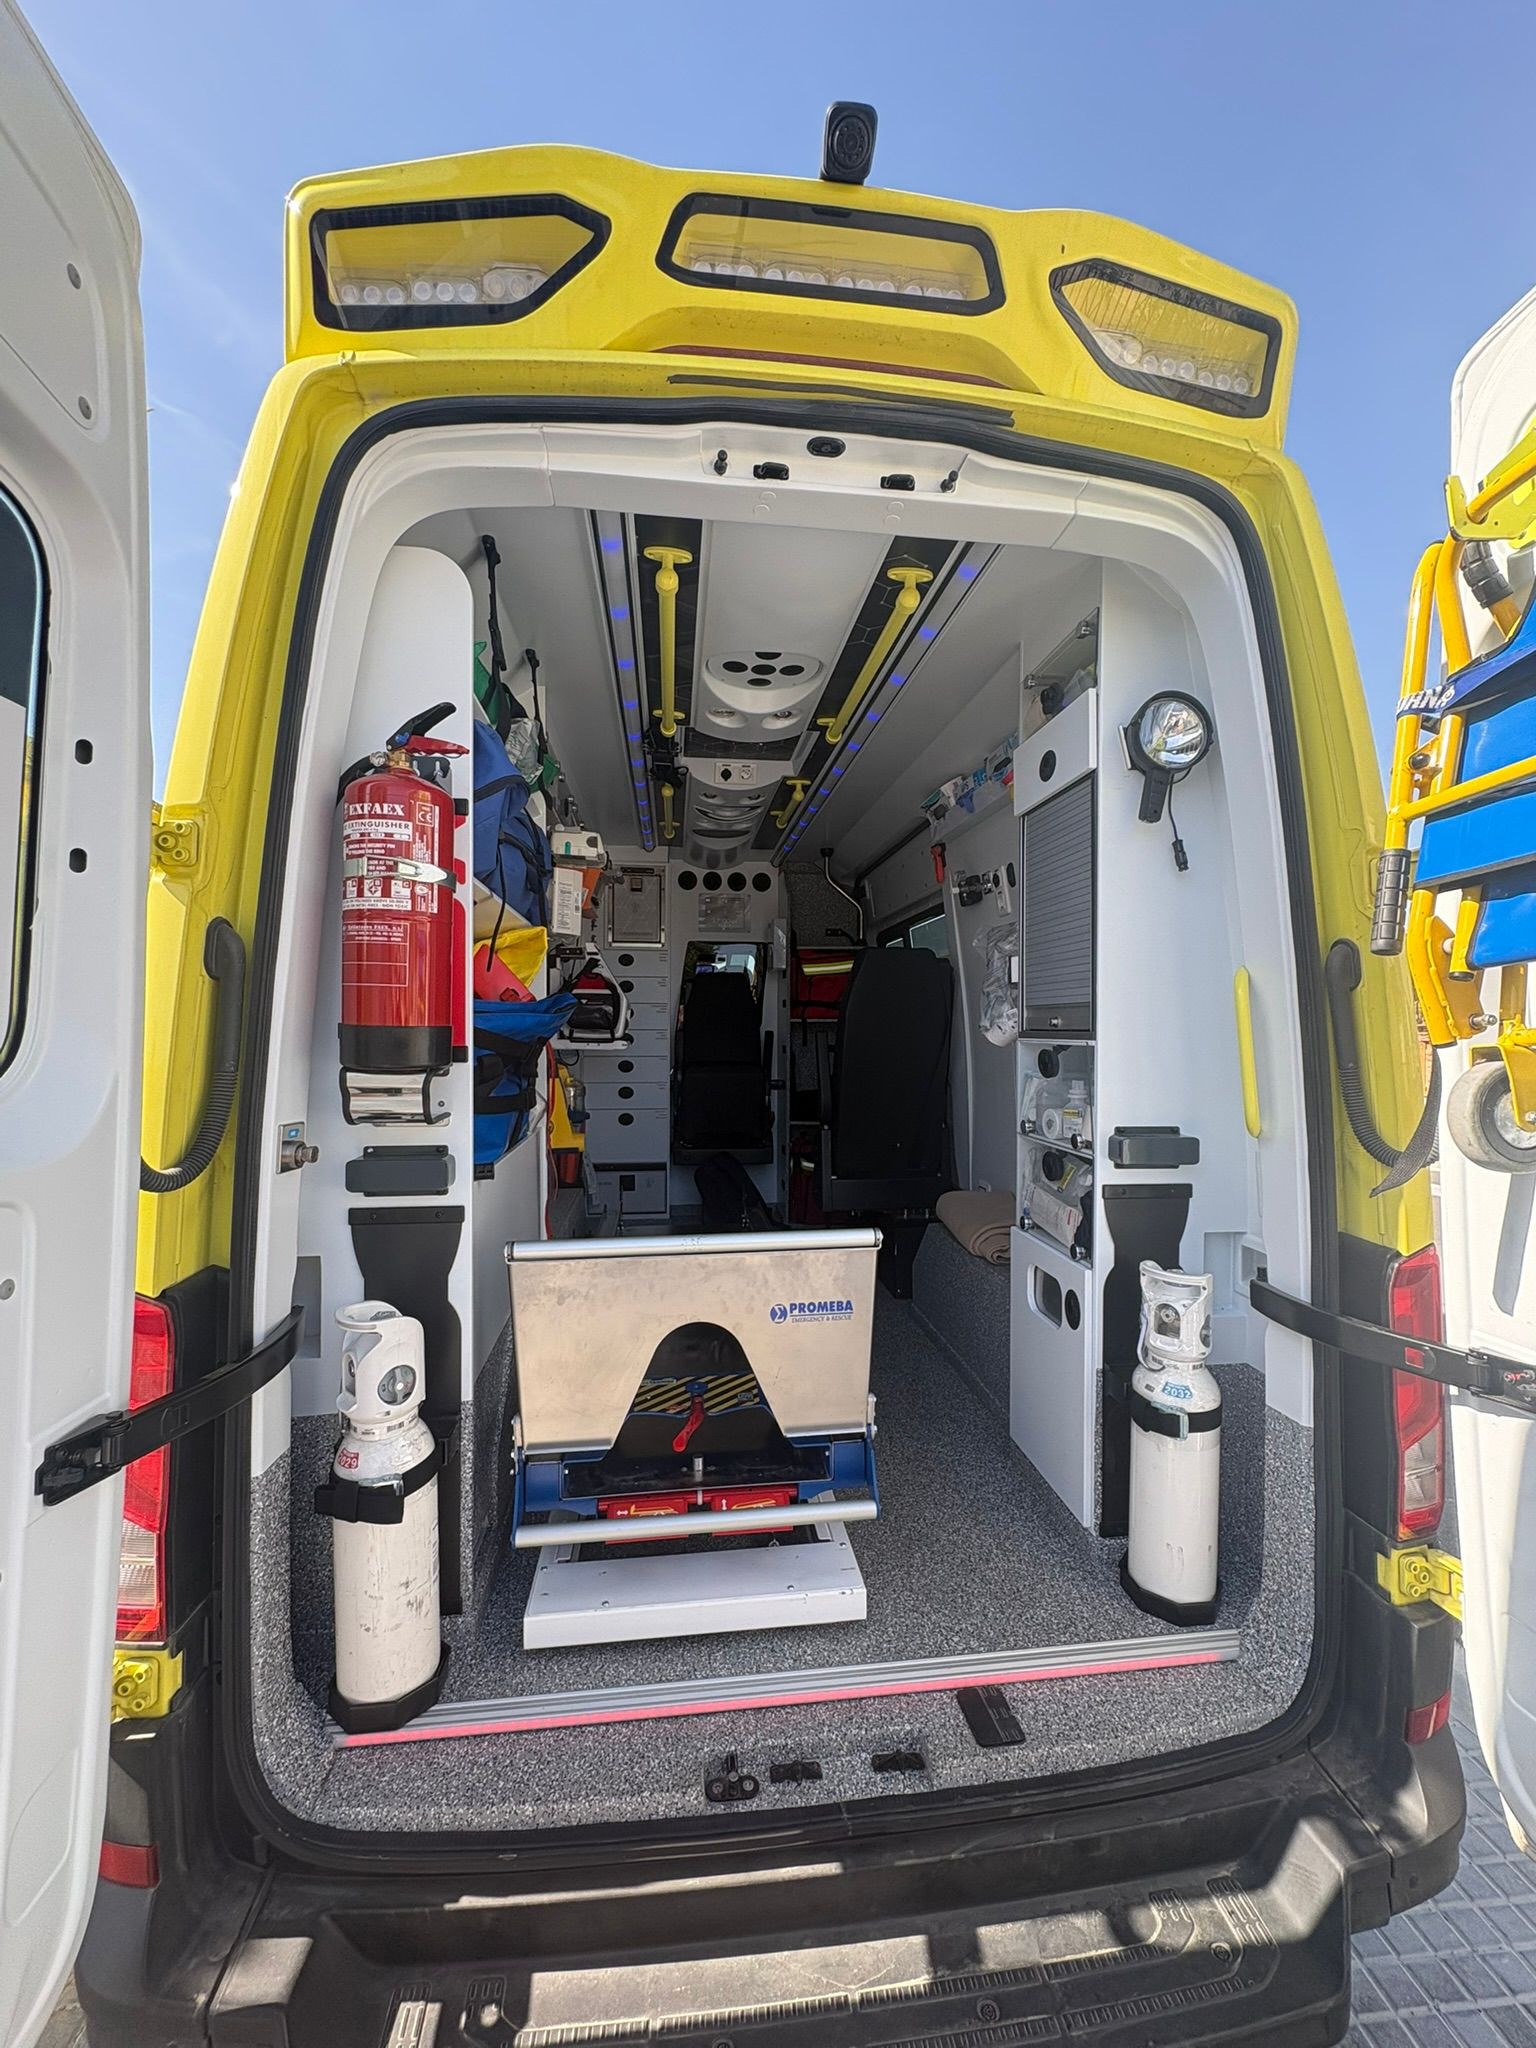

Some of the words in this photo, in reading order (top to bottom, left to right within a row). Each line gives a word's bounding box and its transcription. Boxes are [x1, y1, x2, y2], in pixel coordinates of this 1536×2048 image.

[349, 803, 405, 816] EXFAEX
[348, 821, 410, 830] EXTINGUISHER
[789, 1300, 854, 1314] PROMEBA
[1163, 1385, 1192, 1399] 2032
